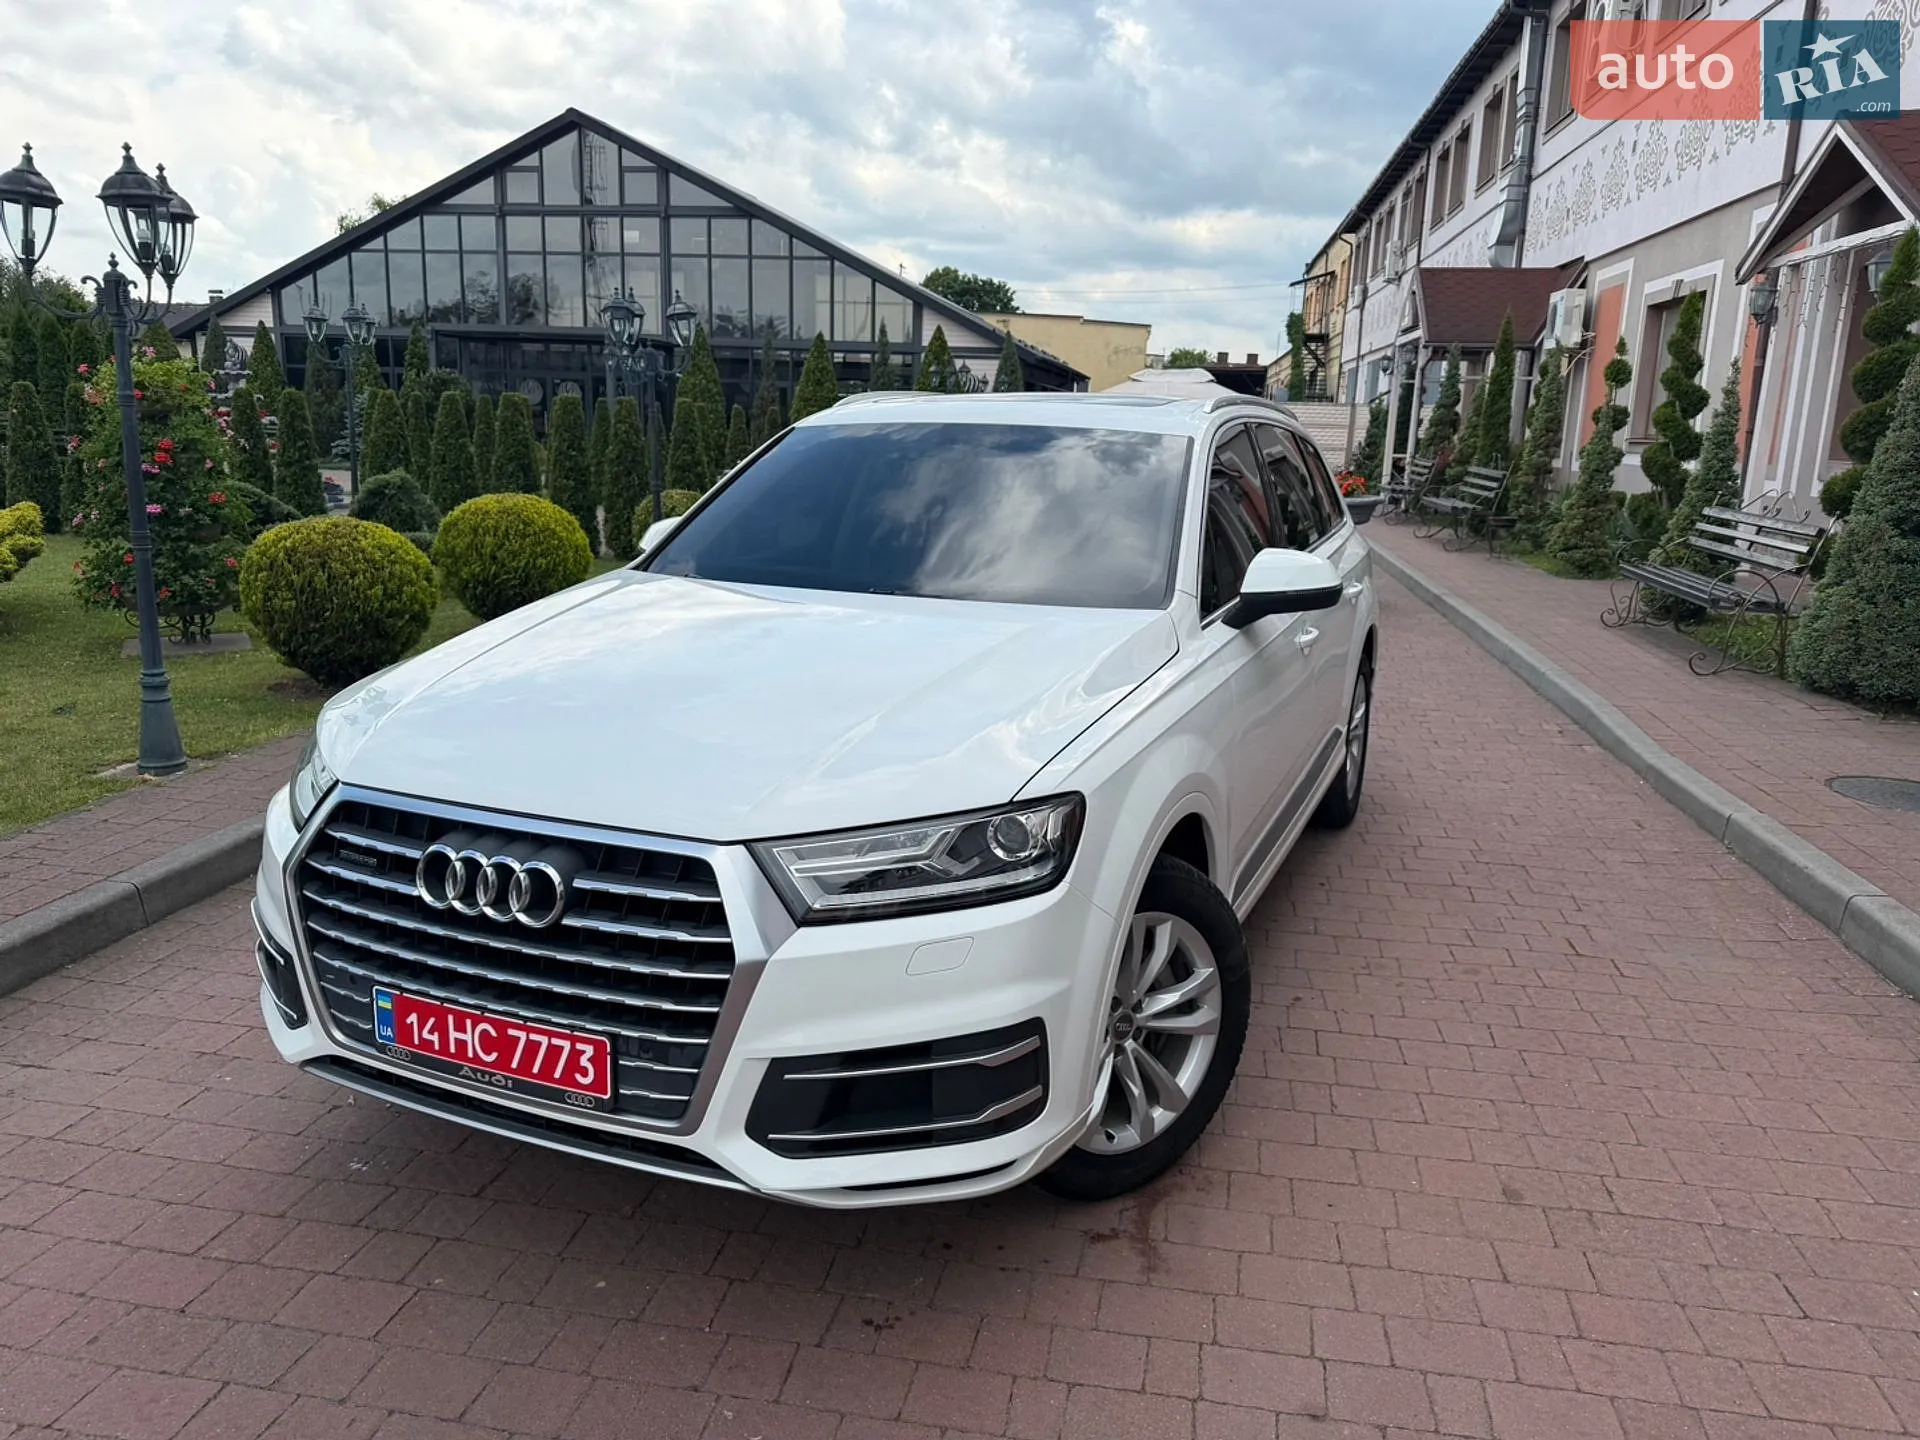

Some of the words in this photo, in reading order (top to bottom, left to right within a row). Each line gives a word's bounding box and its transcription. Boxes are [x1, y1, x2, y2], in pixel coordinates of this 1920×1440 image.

[380, 1025, 394, 1037] UA
[405, 1012, 439, 1051] 14
[447, 1013, 498, 1063] HC
[507, 1028, 595, 1085] 7773
[459, 1066, 512, 1088] Audi
